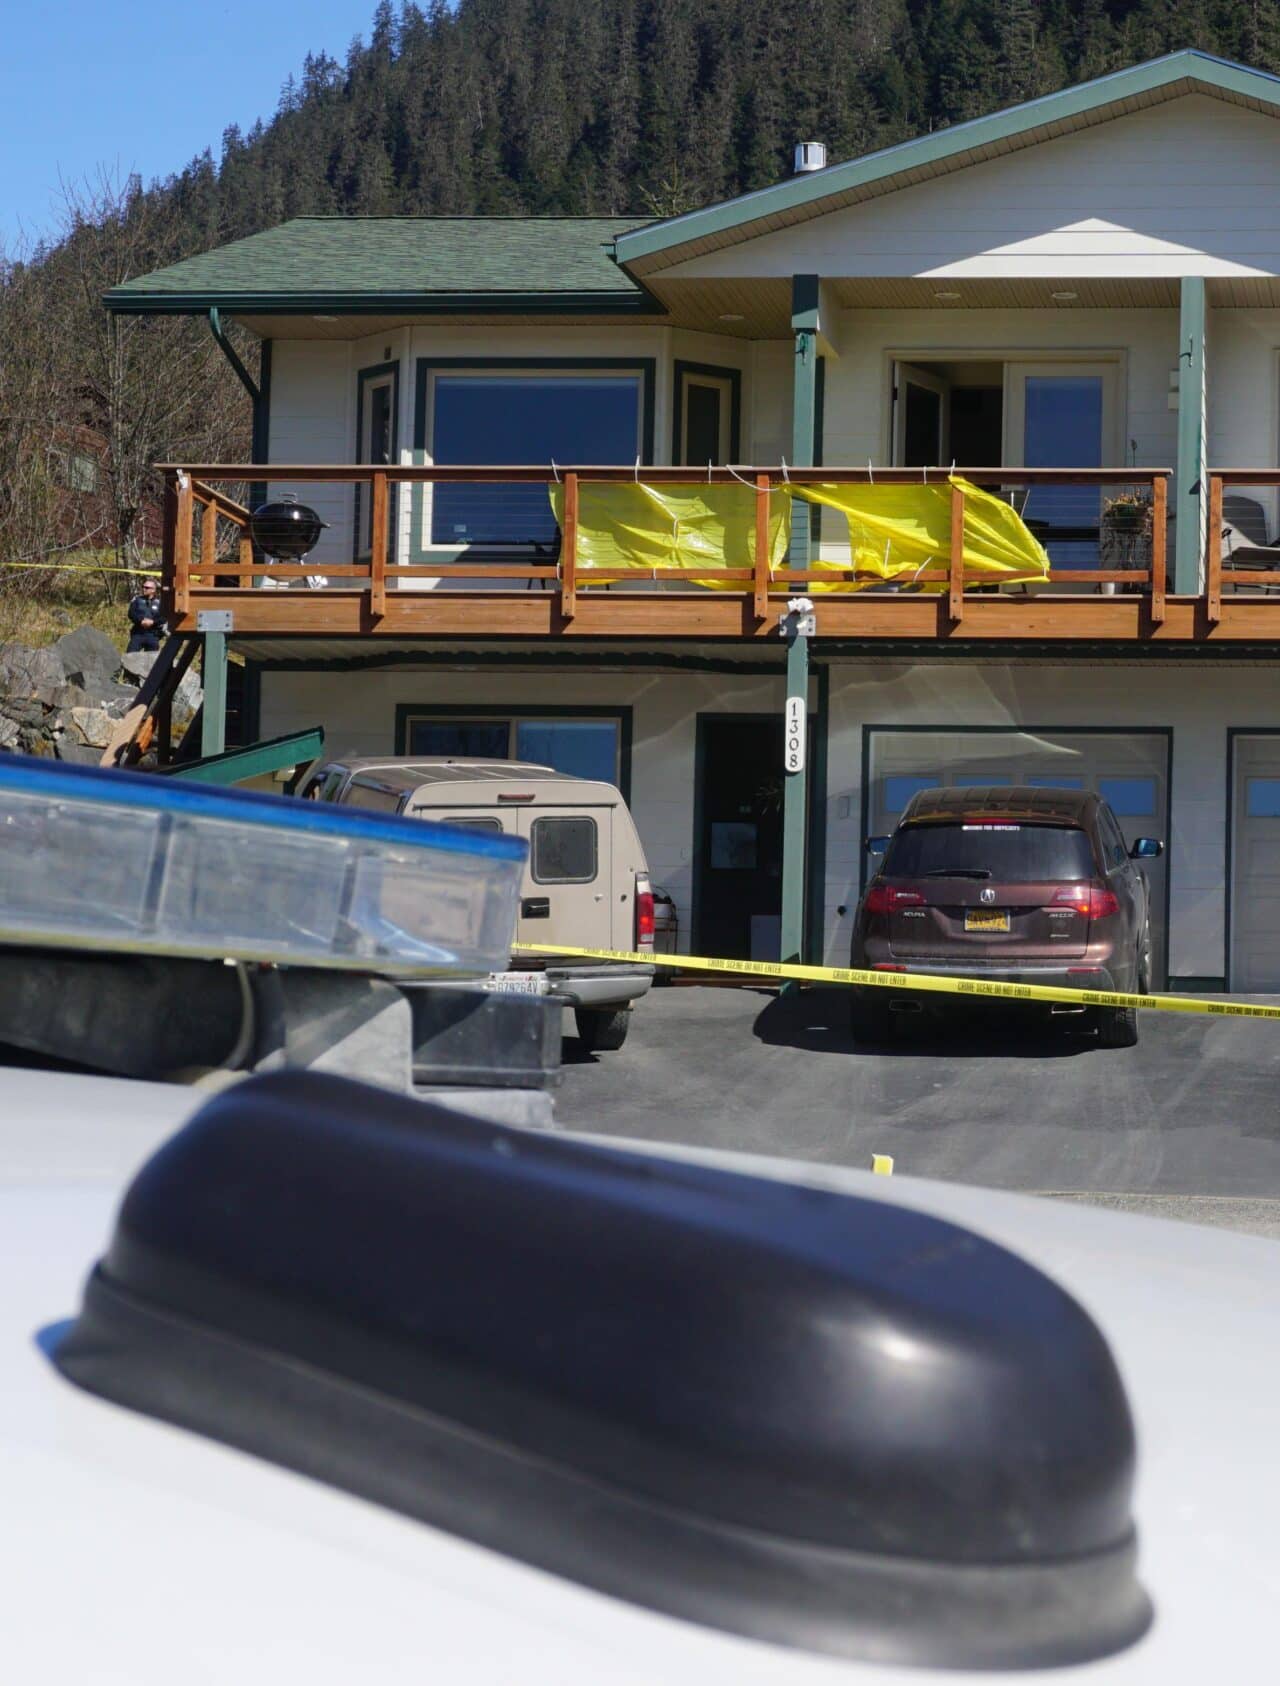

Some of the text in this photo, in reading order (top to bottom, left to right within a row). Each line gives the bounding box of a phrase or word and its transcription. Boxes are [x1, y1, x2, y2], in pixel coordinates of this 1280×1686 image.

[788, 701, 800, 769] 1308
[832, 969, 907, 986] CRIME SCENE DO NOT ENTER
[957, 981, 1032, 997] CRIME SCENE DO NOT ENTER
[1082, 993, 1157, 1008] CRIME SCENE DO NOT ENTER
